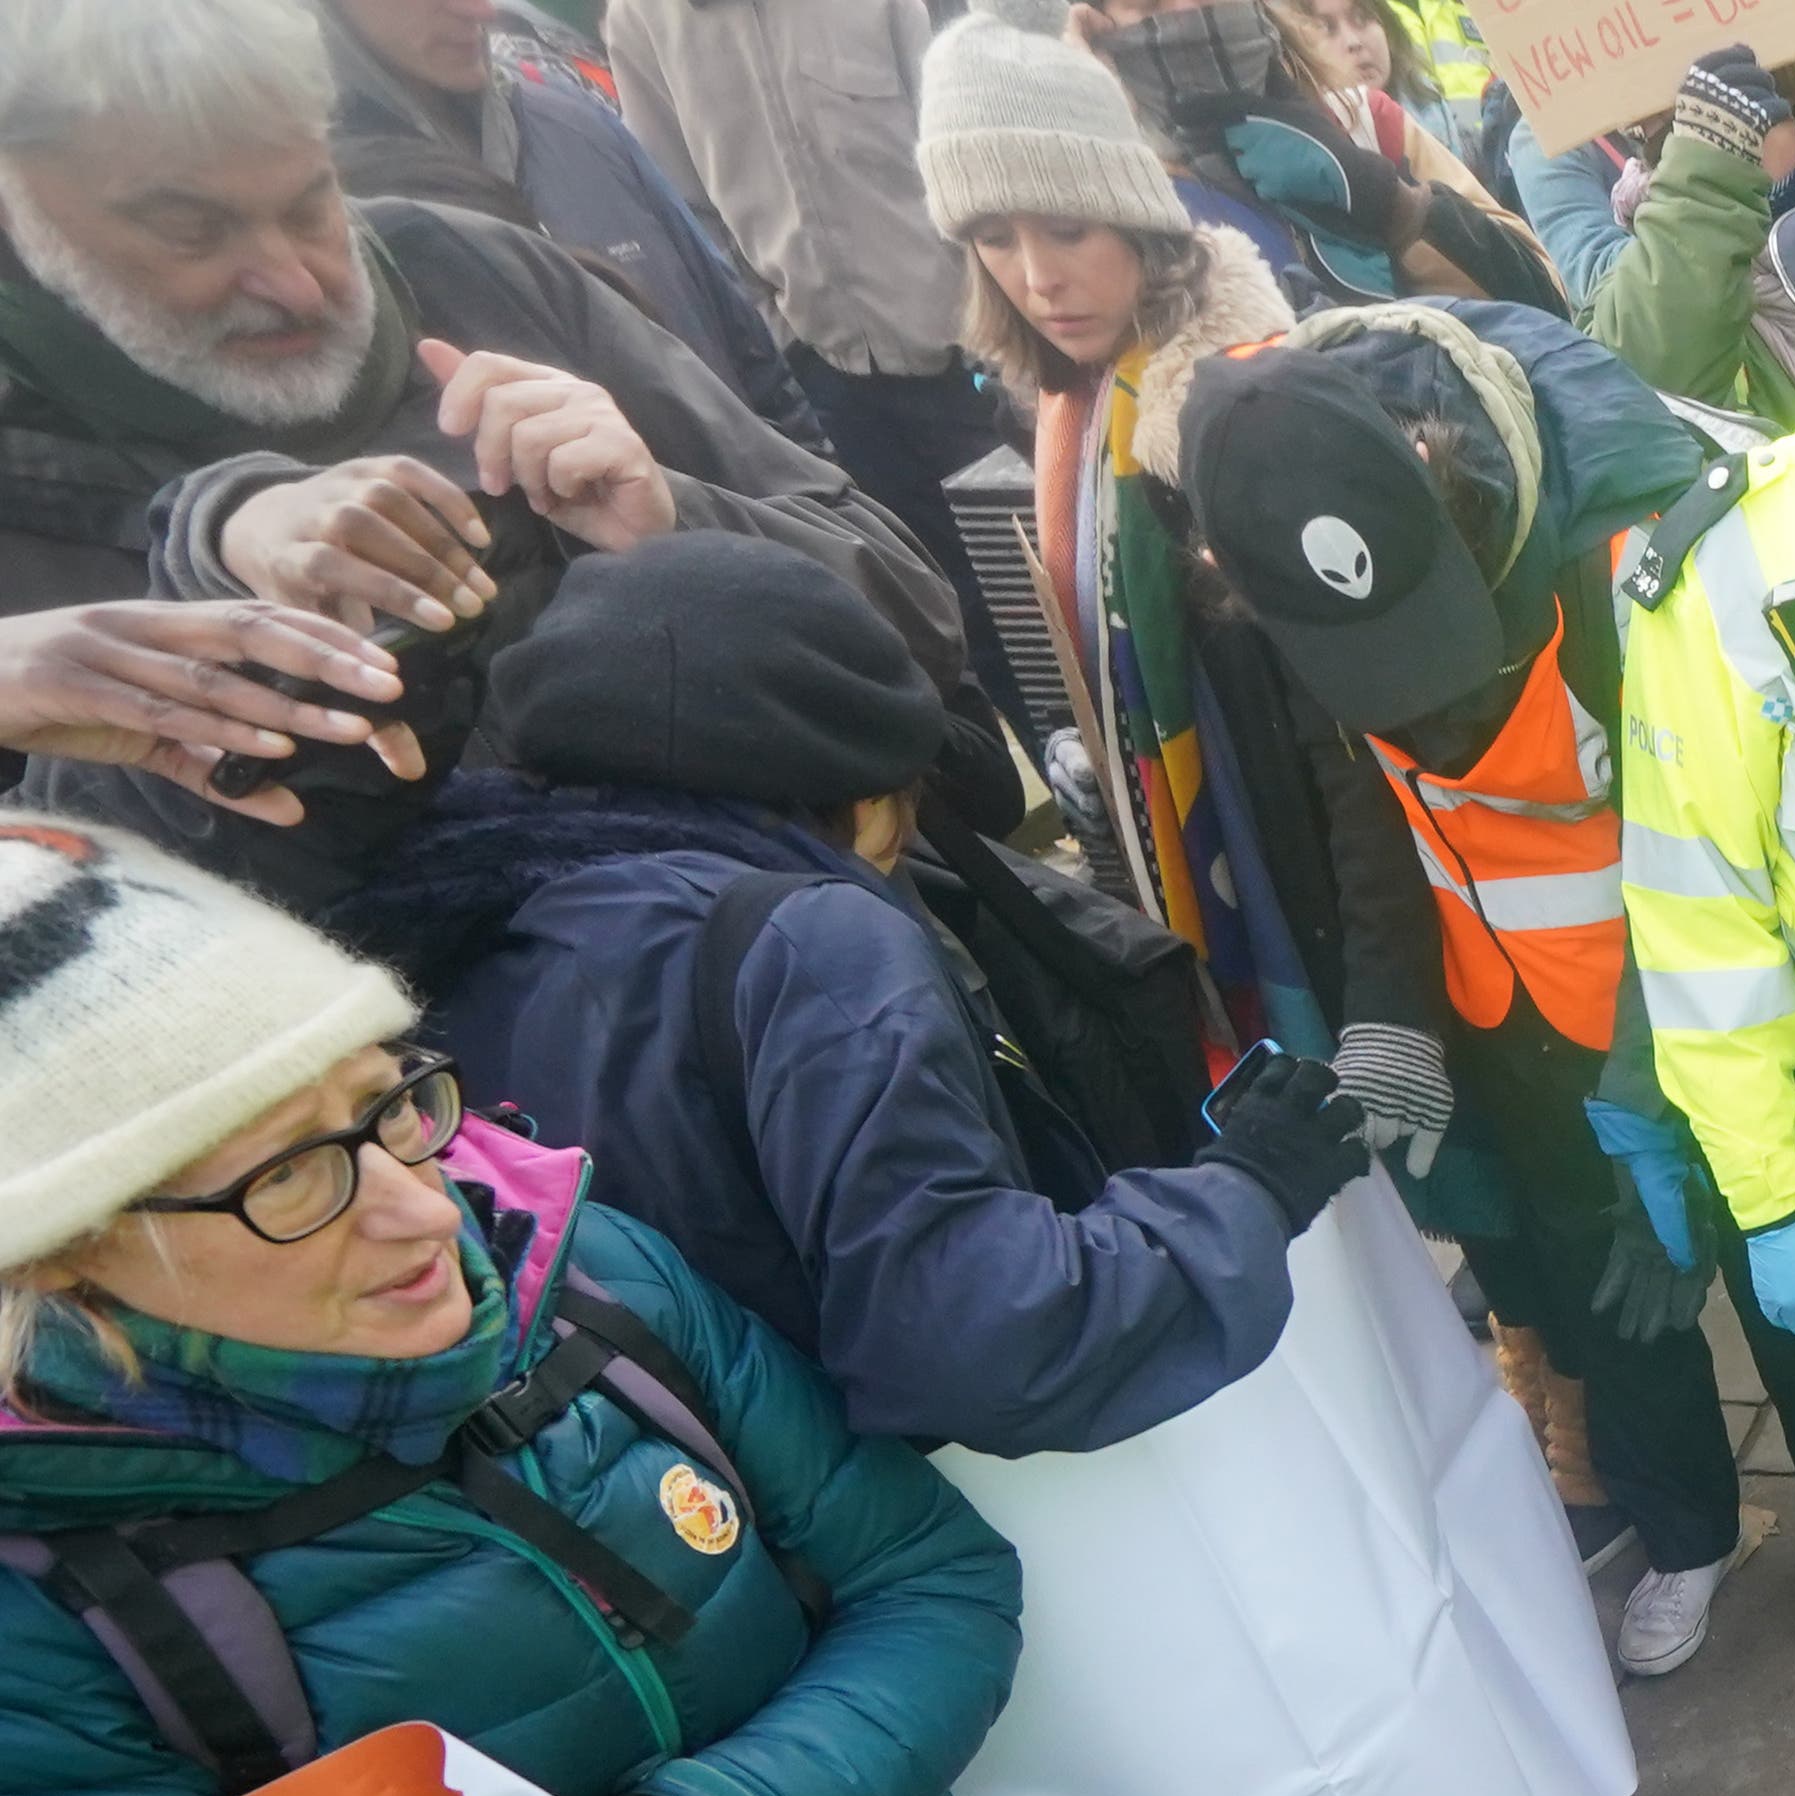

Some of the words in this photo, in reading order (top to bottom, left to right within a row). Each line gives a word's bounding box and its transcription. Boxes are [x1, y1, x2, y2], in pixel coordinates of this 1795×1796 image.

[1507, 26, 1596, 110] NEW
[1597, 2, 1660, 60] OIL
[1629, 713, 1684, 769] POLICE
